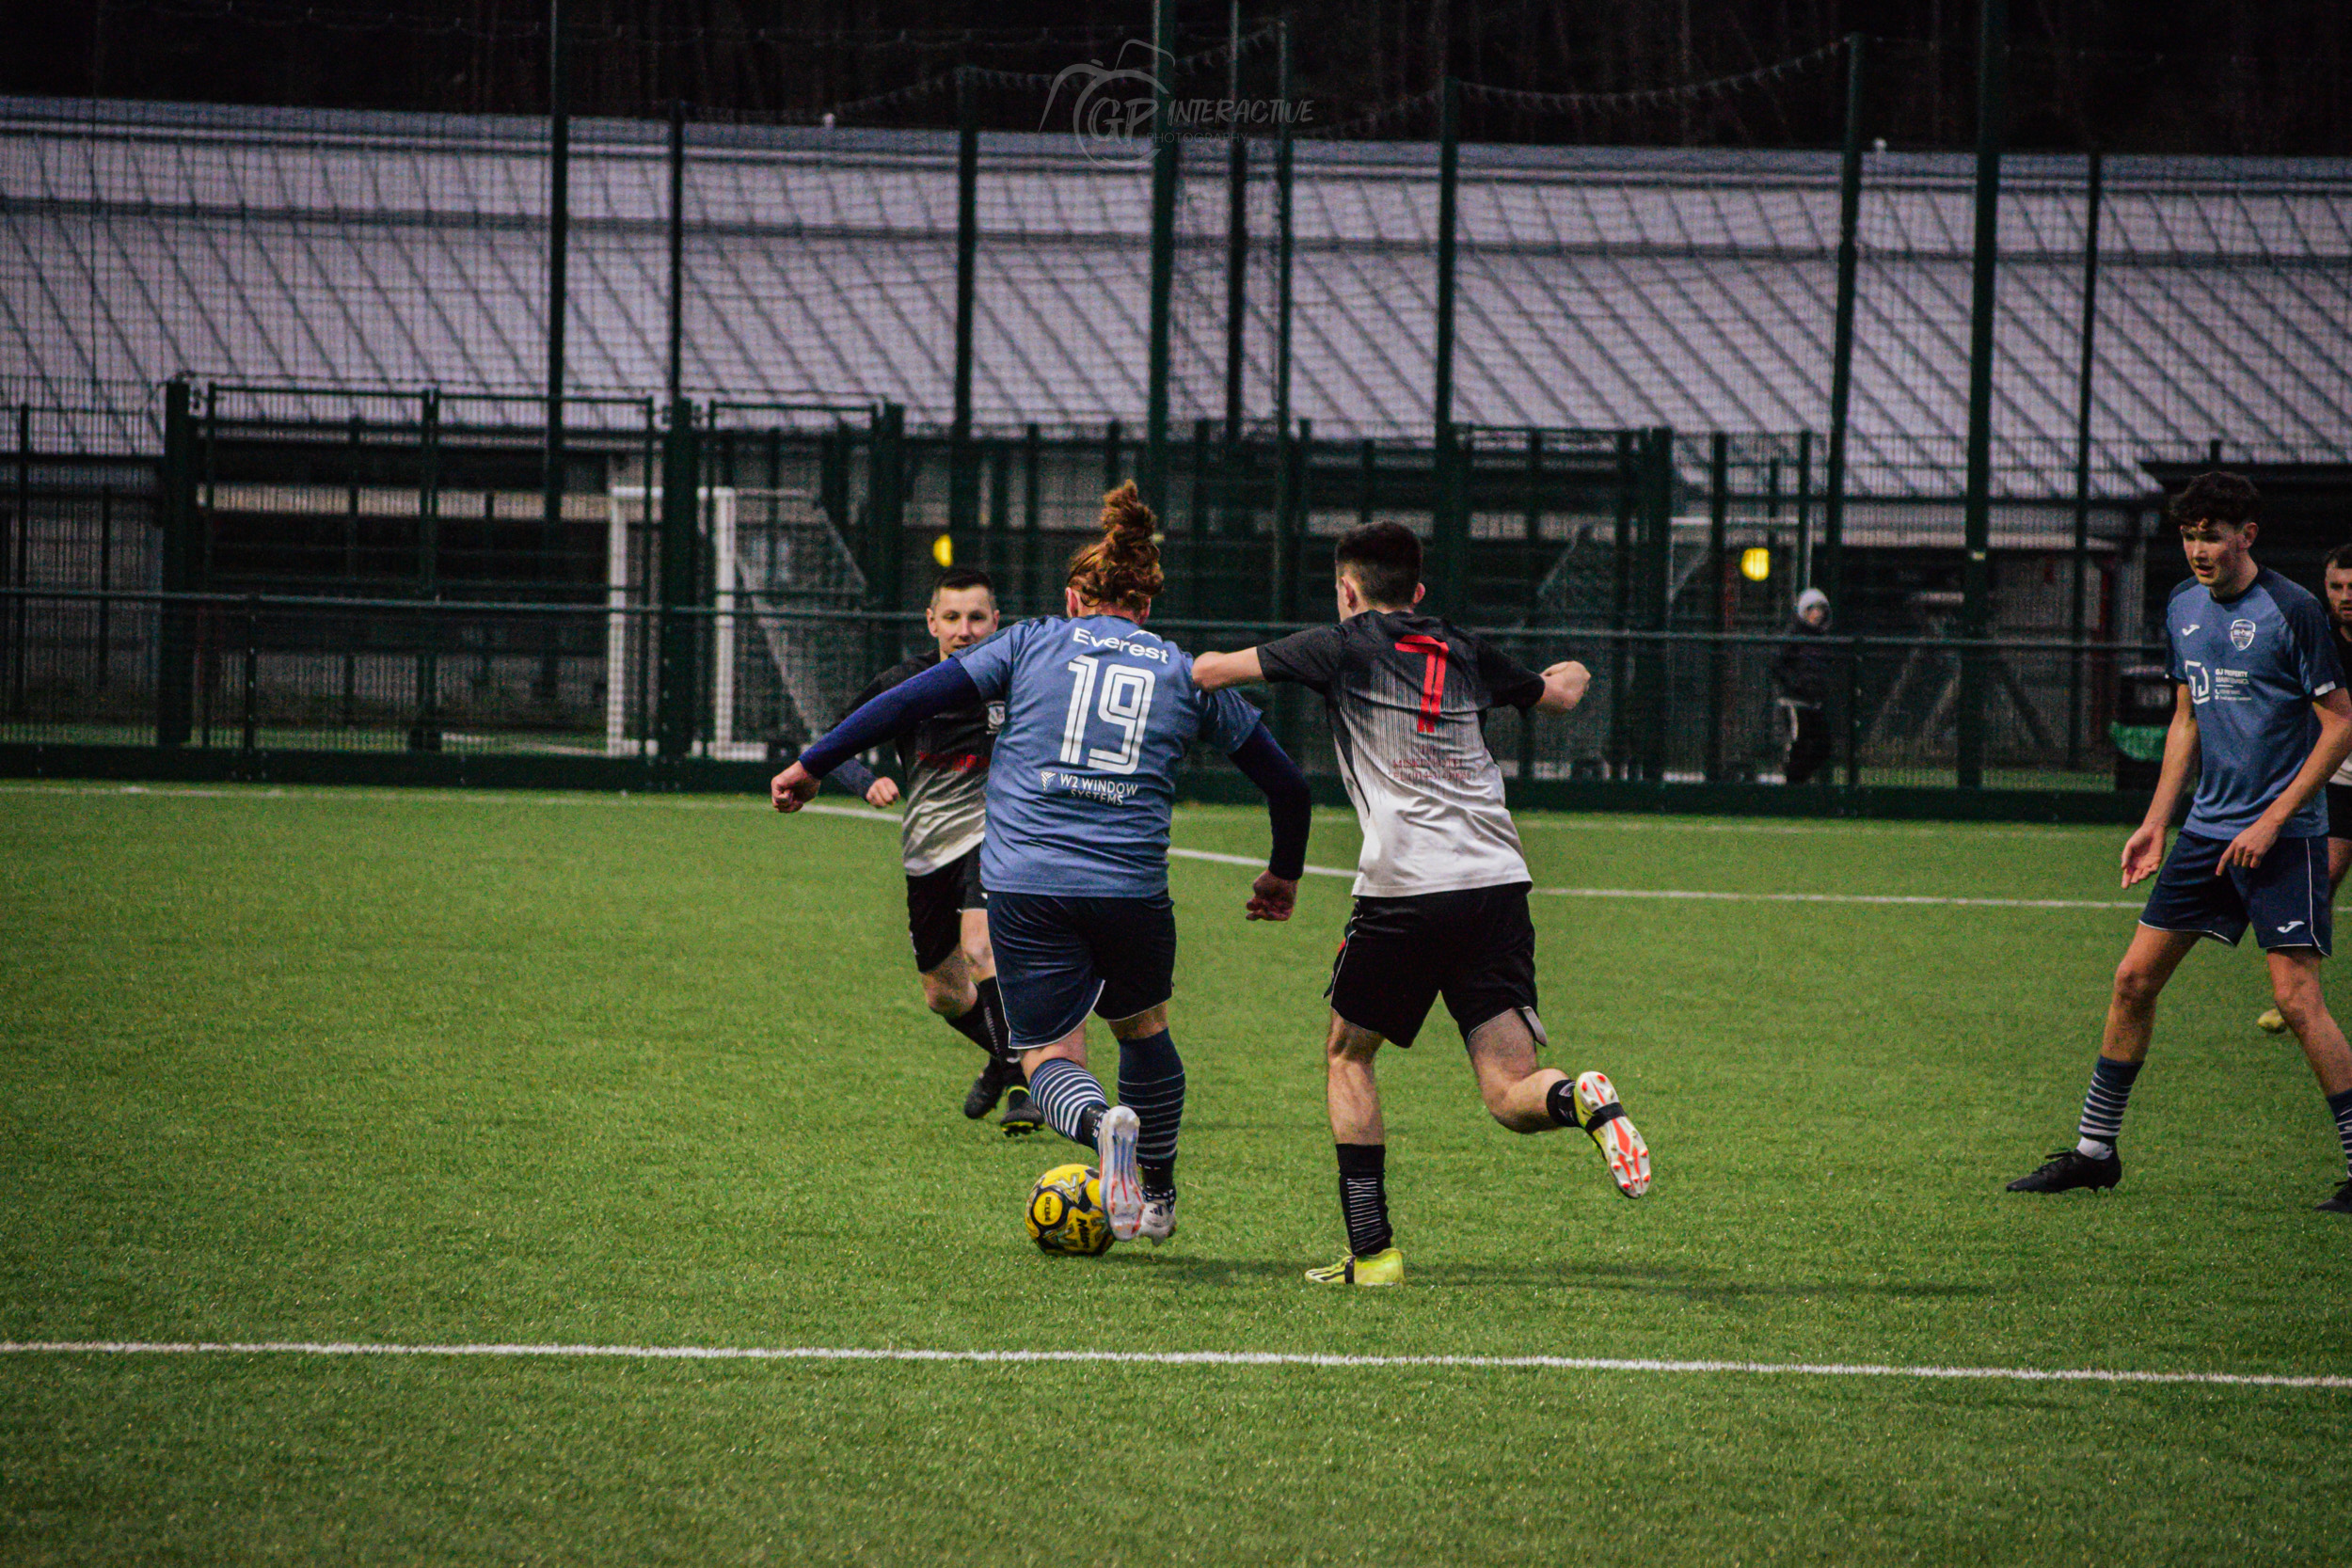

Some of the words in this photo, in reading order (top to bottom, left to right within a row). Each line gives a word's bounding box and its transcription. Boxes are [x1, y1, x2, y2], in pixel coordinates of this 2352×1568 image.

[1073, 627, 1168, 664] Everest
[1394, 634, 1449, 733] 7
[1059, 654, 1156, 775] 19
[1060, 773, 1078, 788] W2
[1082, 777, 1138, 797] WINDOW
[1071, 788, 1123, 806] SYSTEMS
